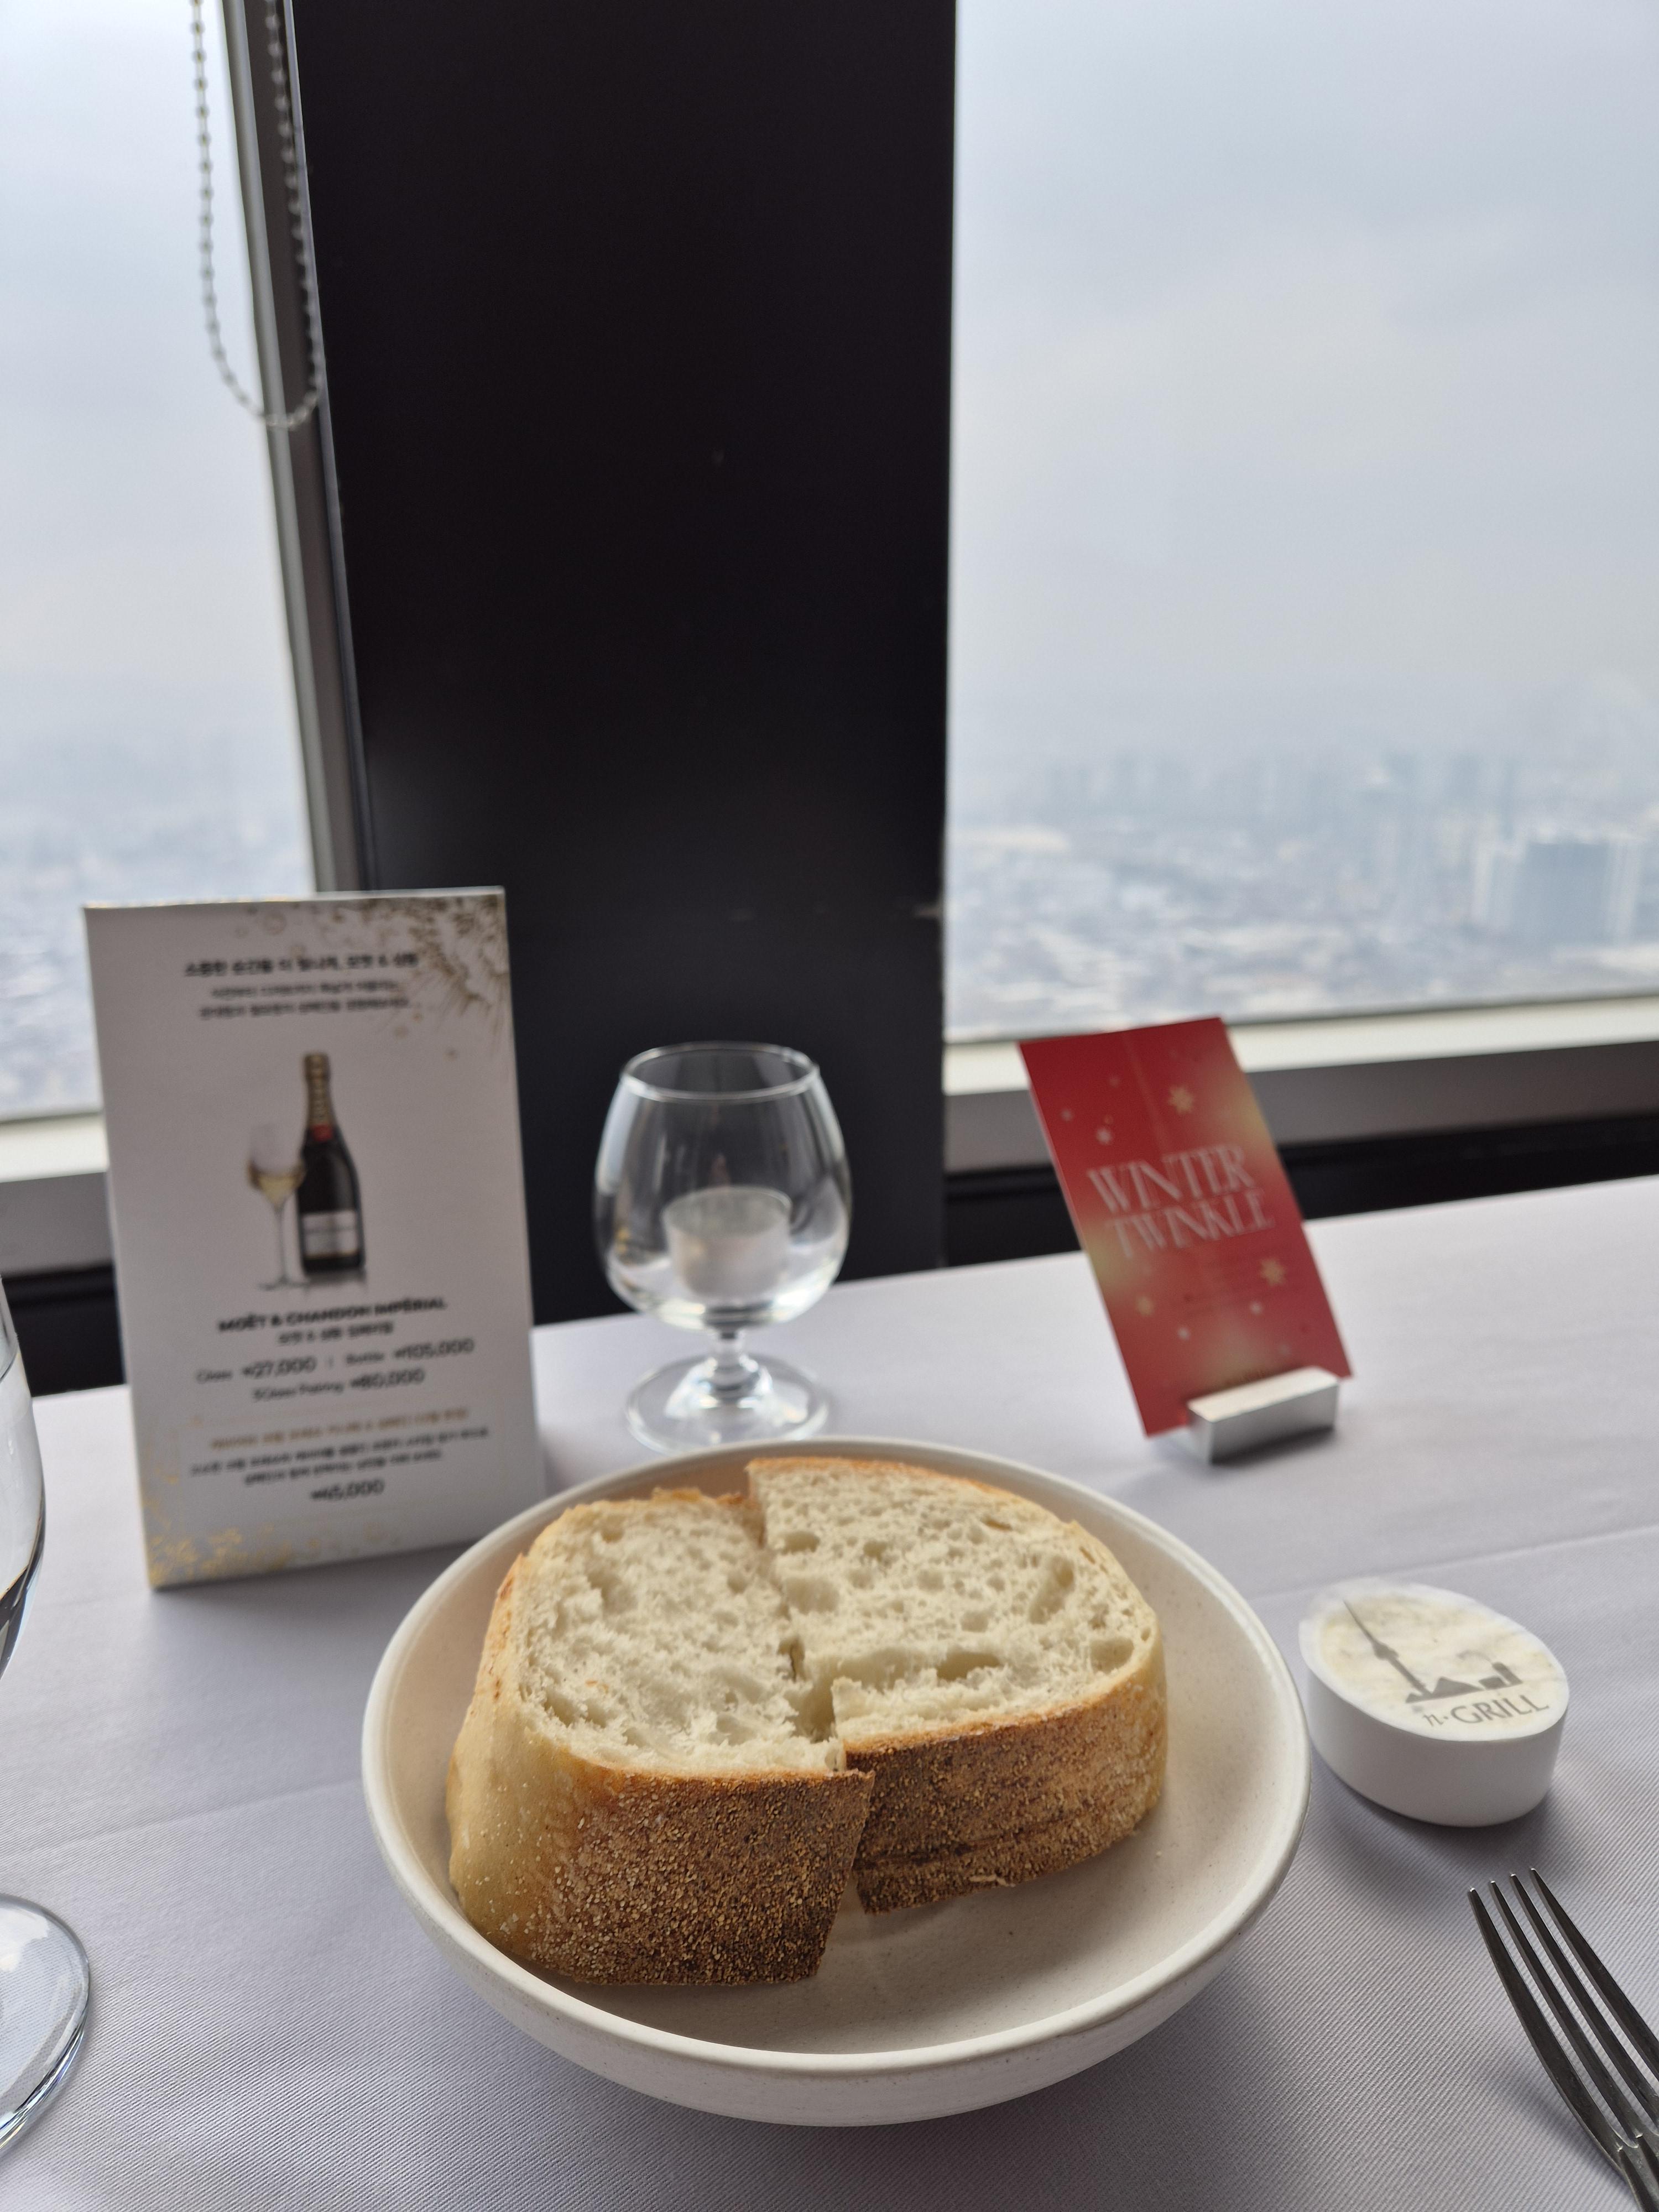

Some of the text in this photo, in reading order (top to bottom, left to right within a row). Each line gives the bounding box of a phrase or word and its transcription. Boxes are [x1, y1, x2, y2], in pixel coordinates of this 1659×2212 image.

[1086, 1145, 1255, 1214] WINTER
[1107, 1188, 1274, 1259] TWINKLE
[272, 1314, 285, 1327] &
[286, 1304, 370, 1324] CHANDON
